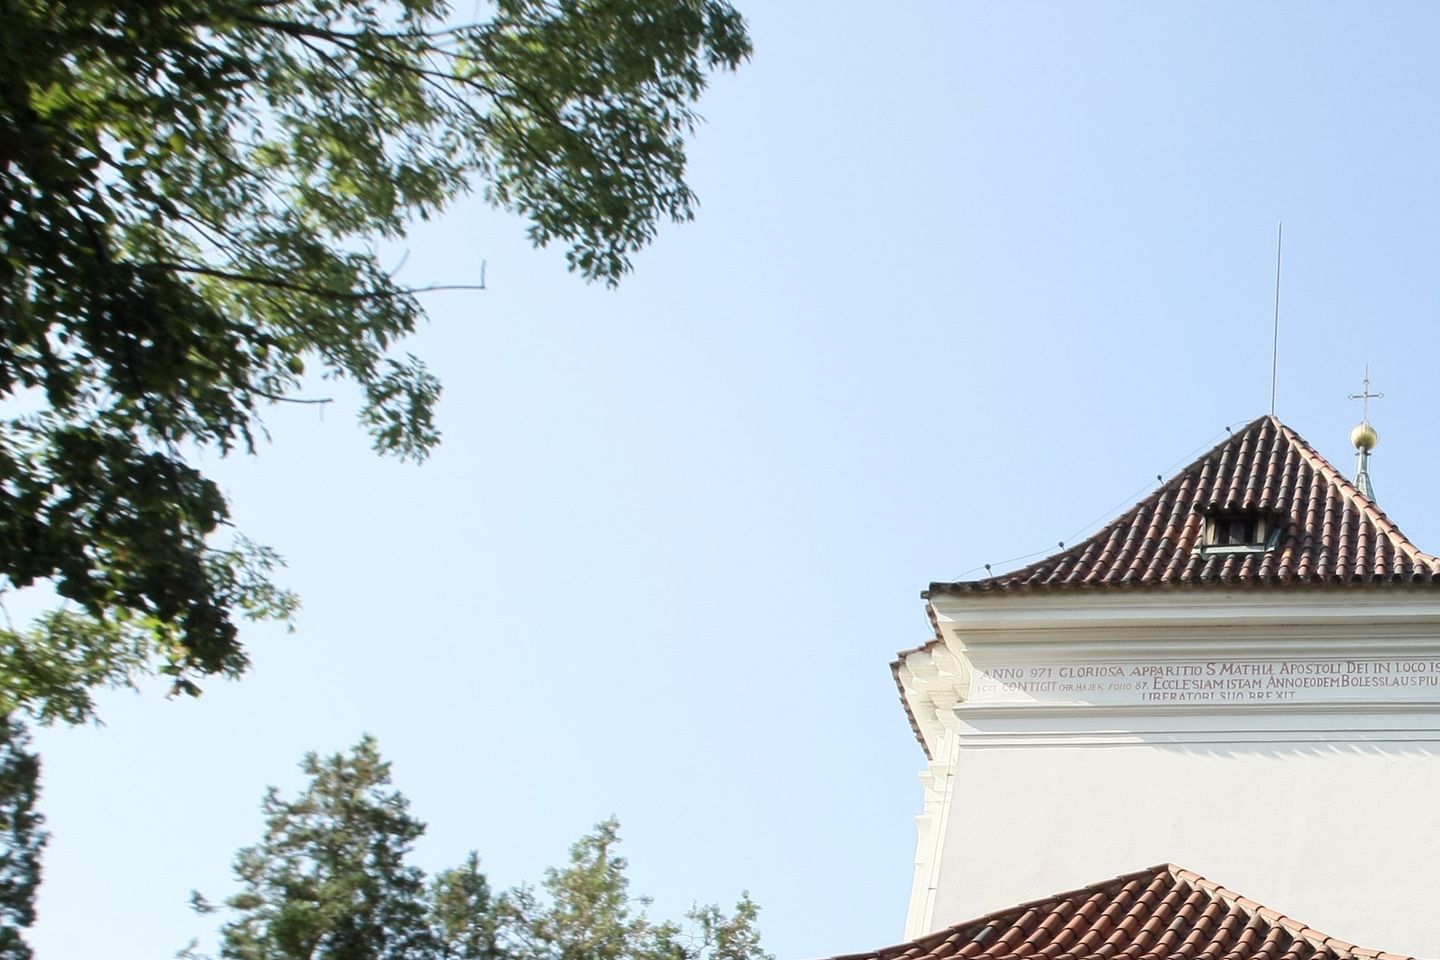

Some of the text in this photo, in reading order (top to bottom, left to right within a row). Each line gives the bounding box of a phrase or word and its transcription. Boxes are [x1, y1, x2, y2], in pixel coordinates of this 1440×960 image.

[980, 668, 1024, 679] ANNO
[1030, 668, 1052, 678] 971
[1059, 666, 1125, 678] GLORIOSA
[1130, 665, 1202, 677] APPARITIO
[1279, 662, 1341, 675] APOSTOLI
[1346, 661, 1368, 674] DEI
[1373, 662, 1391, 673] IN
[1396, 661, 1426, 673] LOCO
[1002, 681, 1058, 692] CONTIGIT
